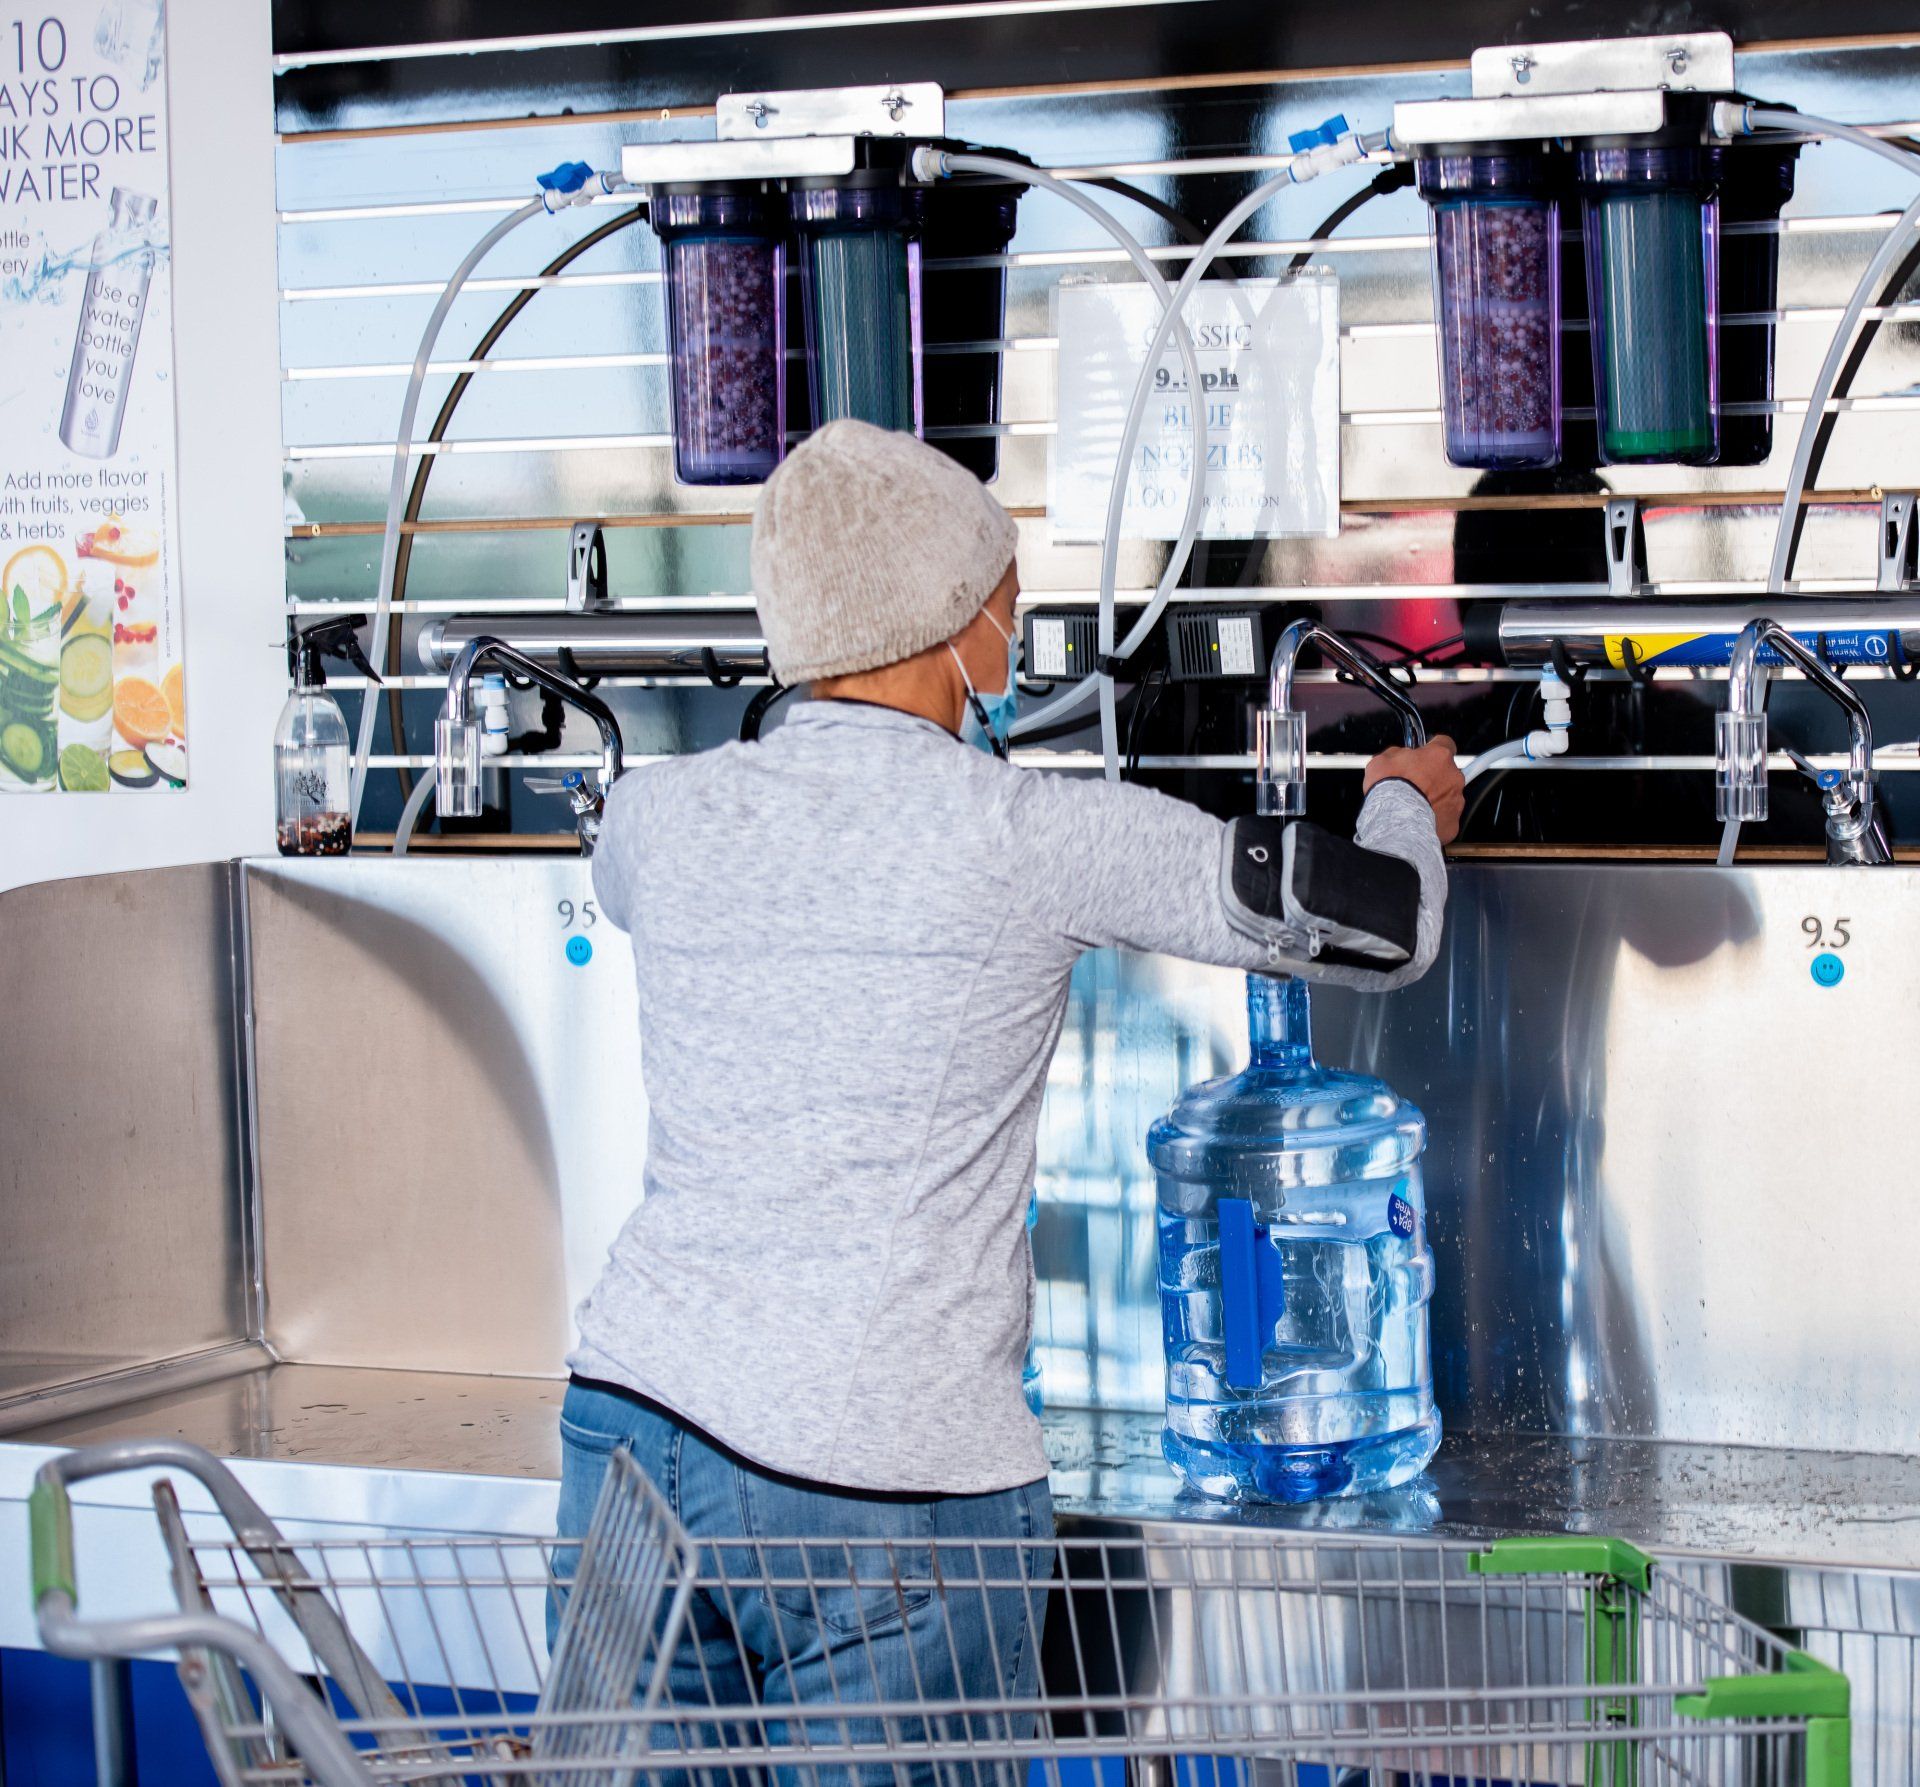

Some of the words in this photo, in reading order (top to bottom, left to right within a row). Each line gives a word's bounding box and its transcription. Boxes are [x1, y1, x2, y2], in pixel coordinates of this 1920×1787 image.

[12, 17, 67, 73] 10
[0, 79, 59, 118] AYS
[71, 75, 120, 113] TO
[45, 115, 156, 158] MORE
[0, 230, 30, 249] ttle
[0, 258, 29, 278] ery
[92, 279, 122, 304] Use
[127, 292, 140, 308] a
[86, 305, 137, 333] water
[81, 325, 132, 359] bottle
[1143, 324, 1252, 348] CSSIC
[86, 357, 118, 380] you
[1155, 366, 1239, 393] 9.ph
[78, 376, 116, 404] love
[1141, 444, 1262, 468] NOZLES
[4, 471, 41, 490] Add
[47, 472, 93, 489] more
[99, 468, 149, 487] flavor
[31, 493, 74, 515] fruits,
[79, 492, 149, 517] veggies
[0, 522, 12, 540] &
[17, 520, 65, 540] herbs
[1824, 647, 1860, 658] Warnin
[1801, 916, 1851, 949] 9.5
[1398, 1213, 1413, 1233] BPA
